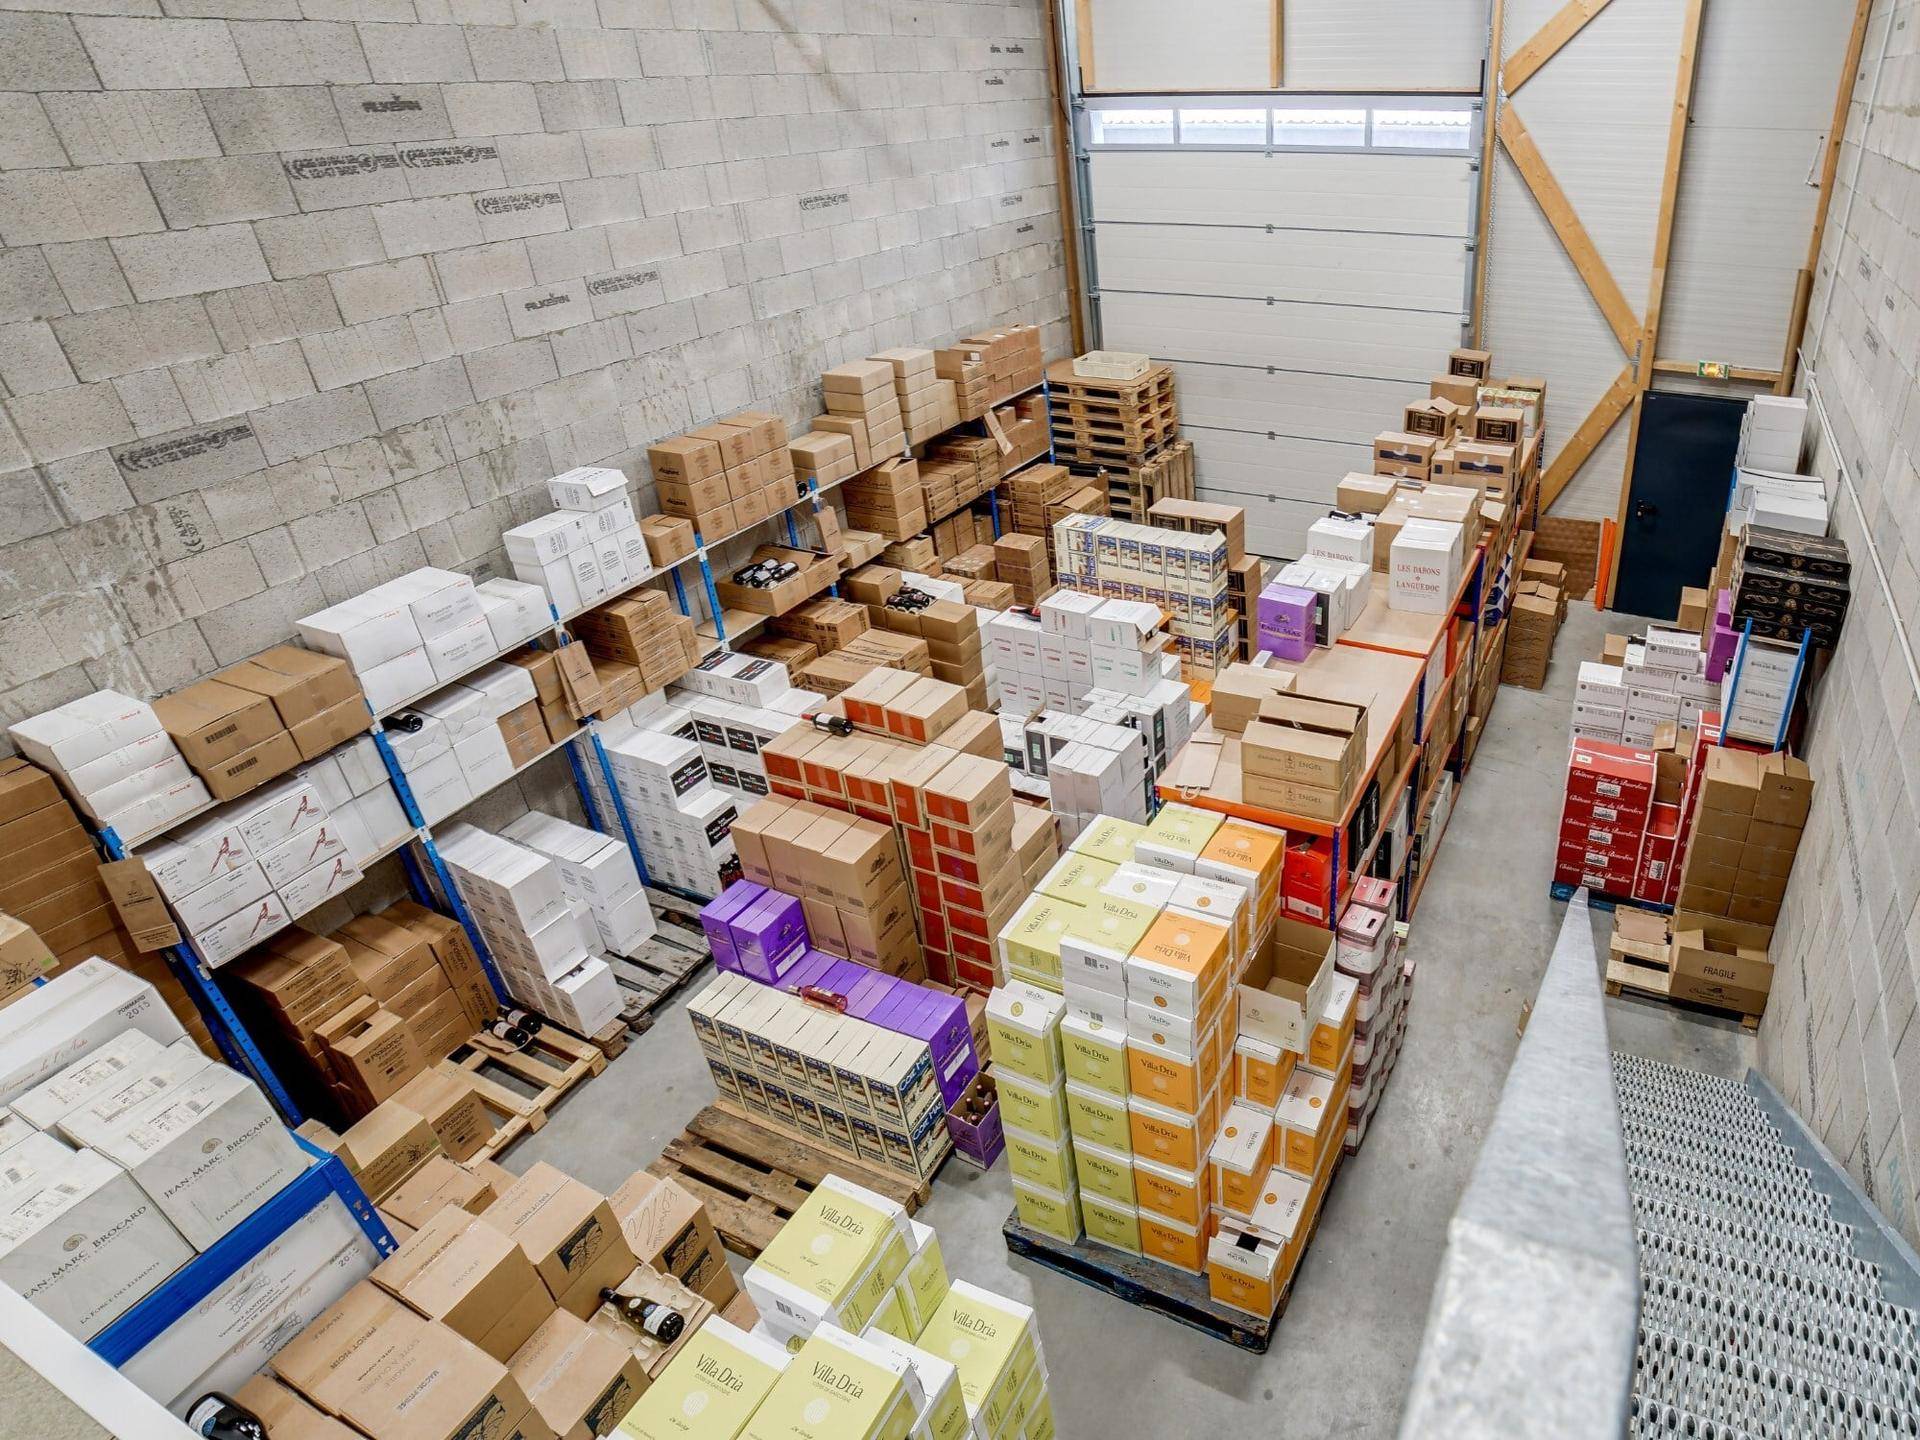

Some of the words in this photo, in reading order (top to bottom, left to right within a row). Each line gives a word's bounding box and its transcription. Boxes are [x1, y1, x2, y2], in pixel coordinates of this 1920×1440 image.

[1397, 564, 1411, 572] LES
[1413, 566, 1441, 576] DARONS
[1396, 581, 1441, 592] LANGUEDOC
[1298, 762, 1322, 771] ENGEL
[1298, 793, 1322, 804] ENGEL
[1103, 902, 1120, 914] Villa
[1118, 907, 1138, 919] Dria
[1149, 976, 1160, 985] Villa
[1160, 979, 1173, 989] Dria
[1704, 966, 1736, 980] FRAGILE
[117, 994, 146, 1015] POMMARD
[126, 1001, 151, 1020] 2015
[998, 1029, 1016, 1042] Villa
[1014, 1036, 1032, 1049] Dria
[1074, 1042, 1092, 1056] Villa
[1091, 1048, 1110, 1062] Dria
[1140, 1058, 1159, 1071] Villa
[1158, 1064, 1178, 1078] Dria
[1079, 1103, 1096, 1116] Villa
[1095, 1108, 1114, 1122] Dria
[1142, 1122, 1160, 1135] Villa
[1160, 1126, 1179, 1140] Dria
[164, 1153, 223, 1199] JEAN-MARC
[225, 1115, 272, 1152] BROCARD
[1146, 1178, 1162, 1190] Villa
[1162, 1184, 1182, 1197] Dria
[530, 1192, 550, 1211] PINOT
[514, 1210, 532, 1225] NOIR
[818, 1204, 842, 1224] Villa
[840, 1213, 864, 1236] Dria
[22, 1250, 89, 1300] EAN-MARC
[92, 1206, 147, 1248] BROCARD
[1220, 1271, 1237, 1282] Villa
[1237, 1277, 1255, 1290] Dria
[245, 1288, 274, 1315] SANTENAY
[952, 1309, 974, 1330] Villa
[972, 1318, 997, 1338] Dria
[352, 1327, 378, 1351] PINOT
[330, 1350, 353, 1370] NOIR
[695, 1352, 718, 1378] Villa
[716, 1366, 744, 1394] Dria
[812, 1361, 836, 1386] Villa
[834, 1374, 865, 1400] Dria
